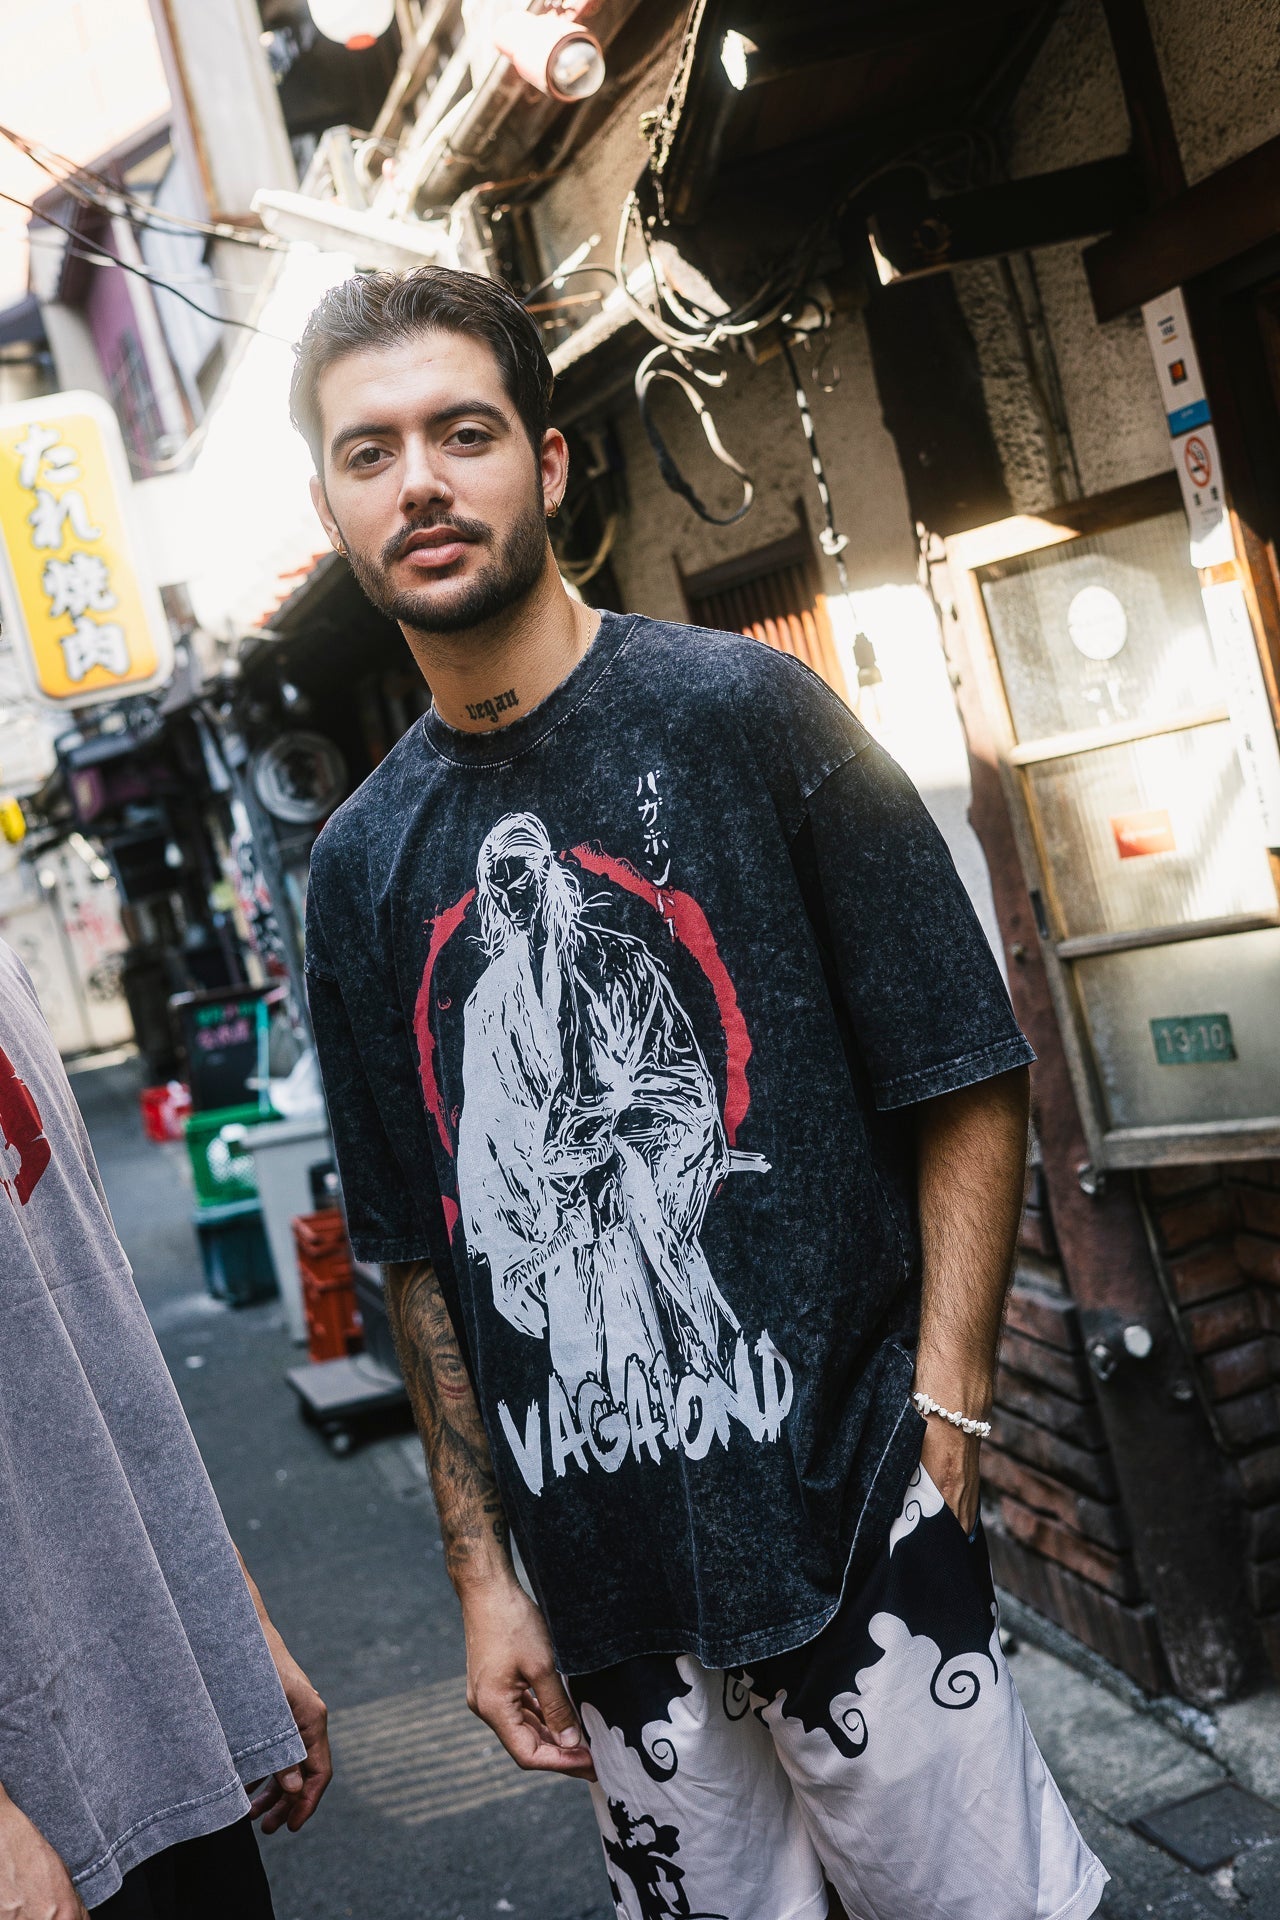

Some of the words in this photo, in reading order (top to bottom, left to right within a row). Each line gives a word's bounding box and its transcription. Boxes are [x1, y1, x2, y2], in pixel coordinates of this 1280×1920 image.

[15, 423, 130, 682] たれ焼肉
[465, 688, 519, 723] vegan
